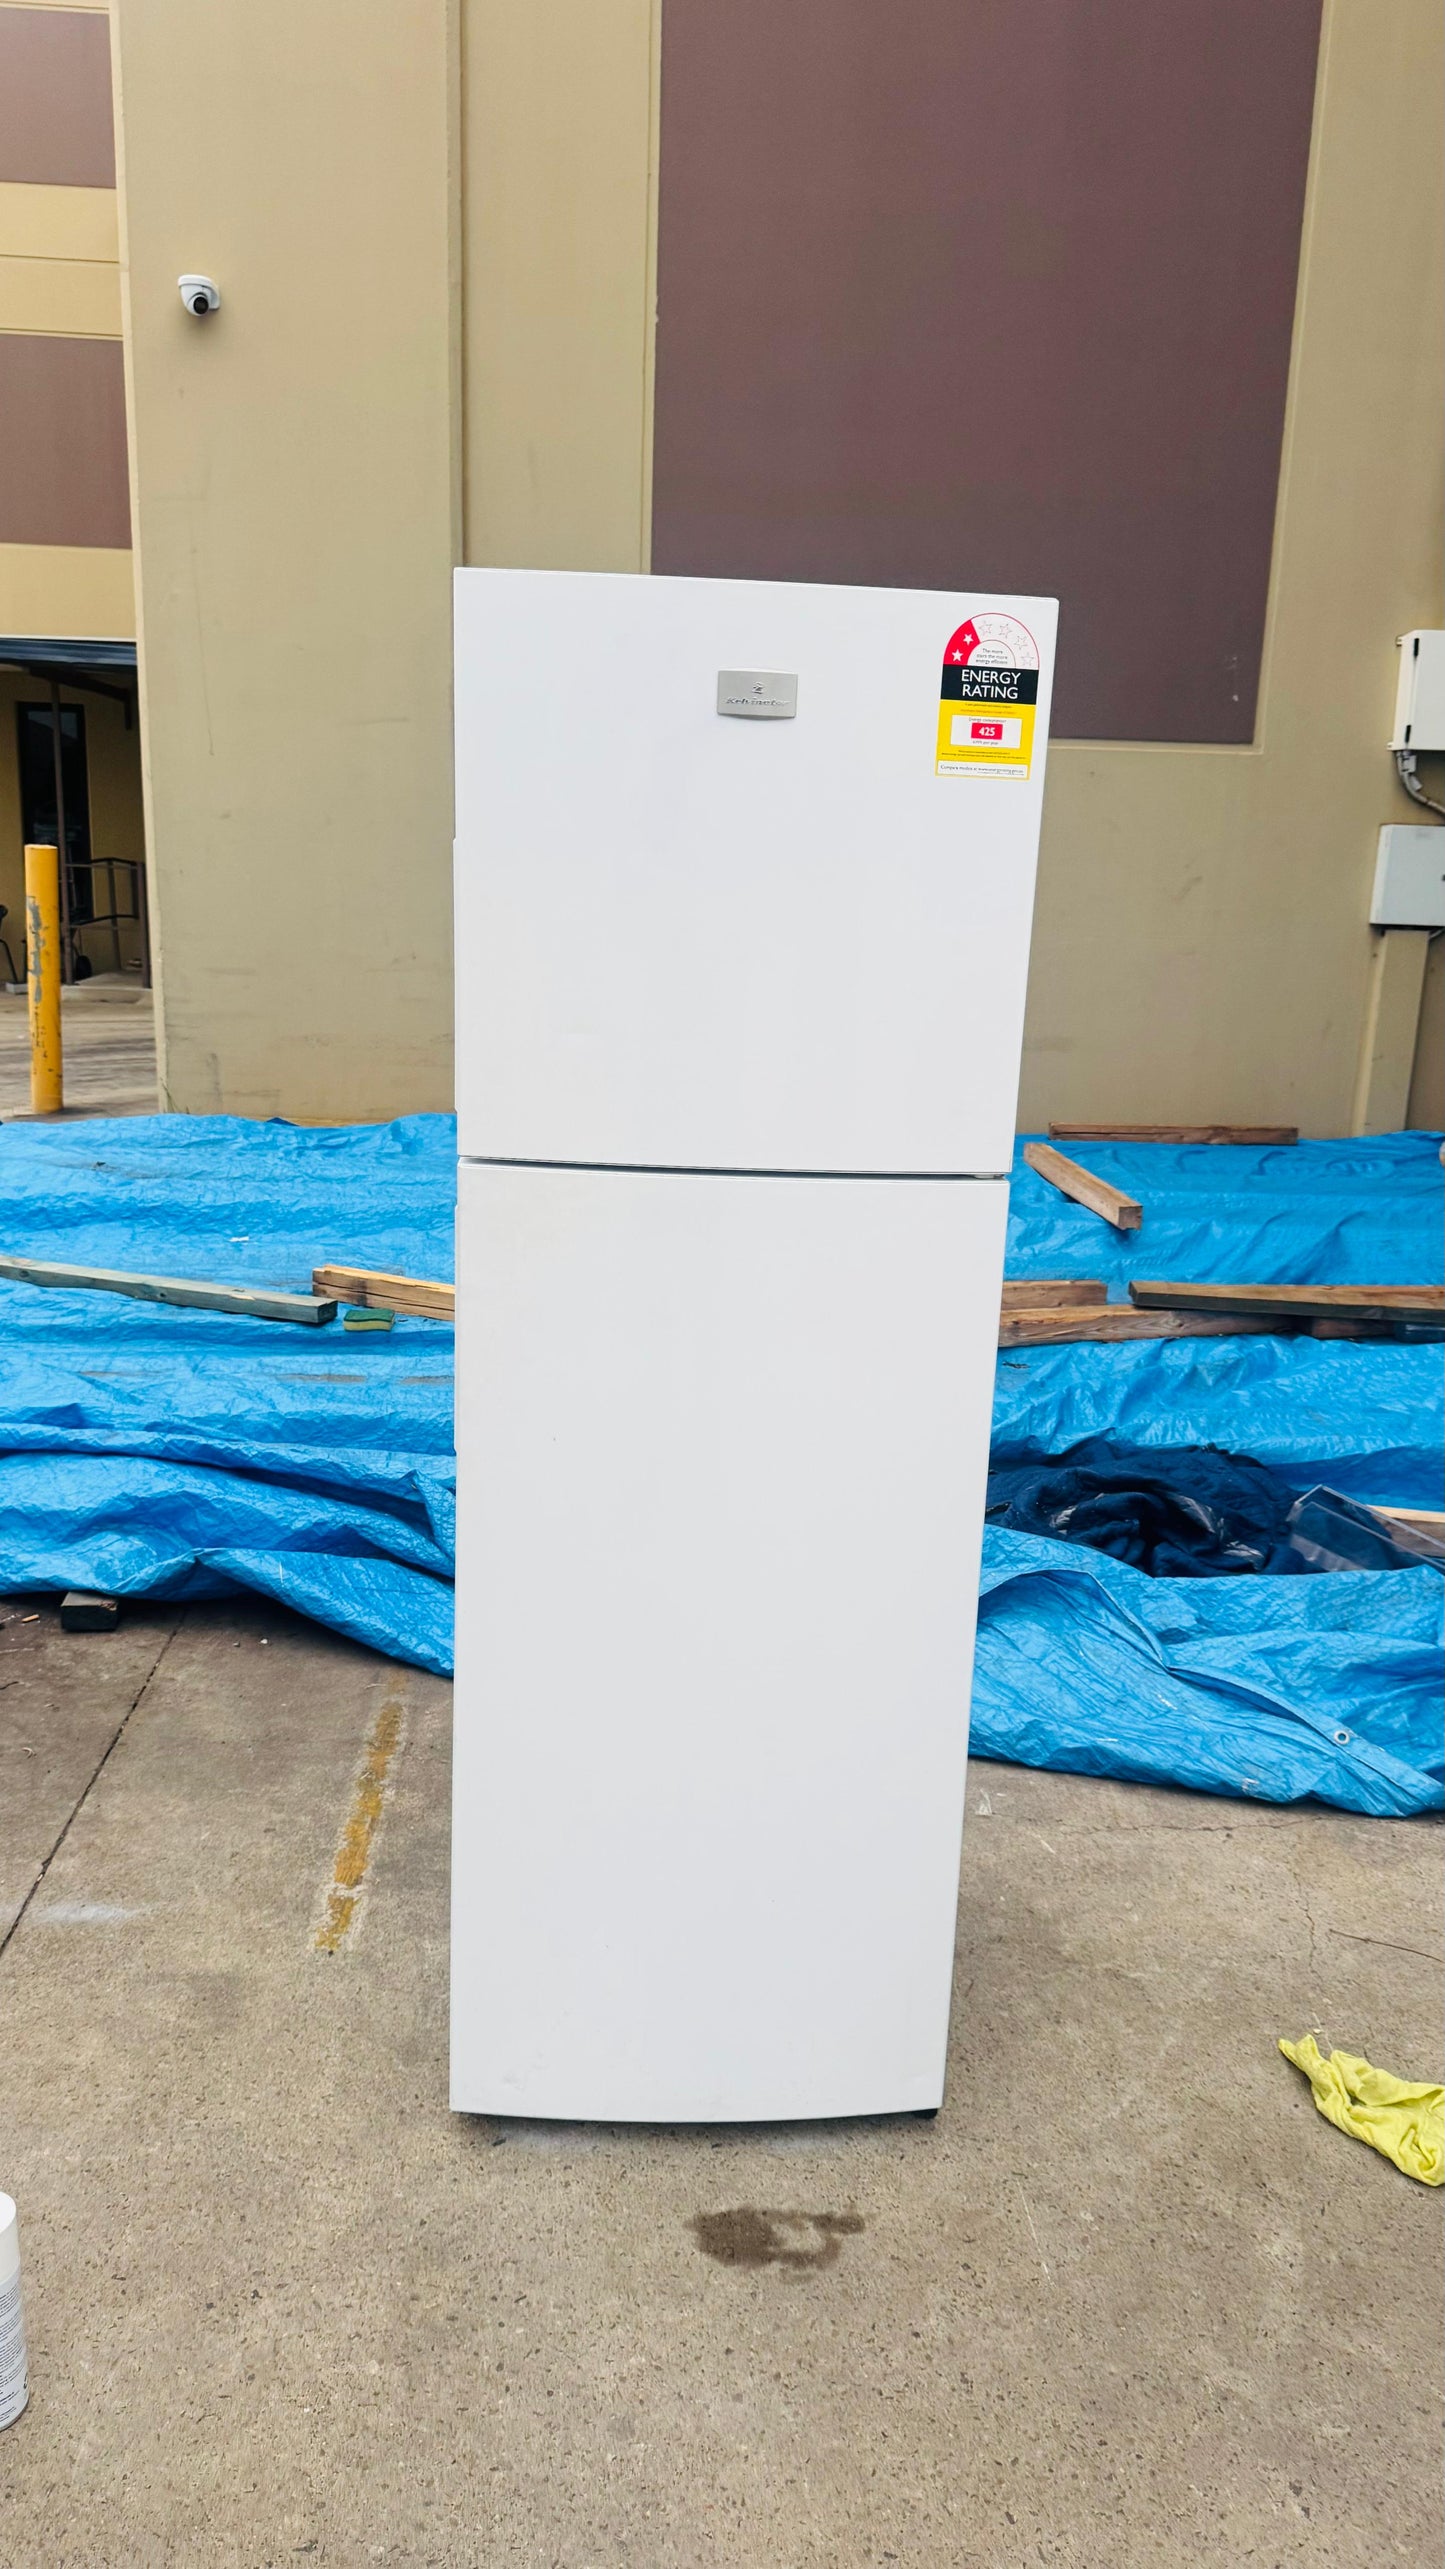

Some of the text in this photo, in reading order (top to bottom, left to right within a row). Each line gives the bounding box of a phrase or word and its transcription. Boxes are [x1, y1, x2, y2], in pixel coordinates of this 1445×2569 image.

[961, 669, 1021, 685] ENERGY
[962, 684, 1018, 699] RATING
[978, 726, 995, 736] 425
